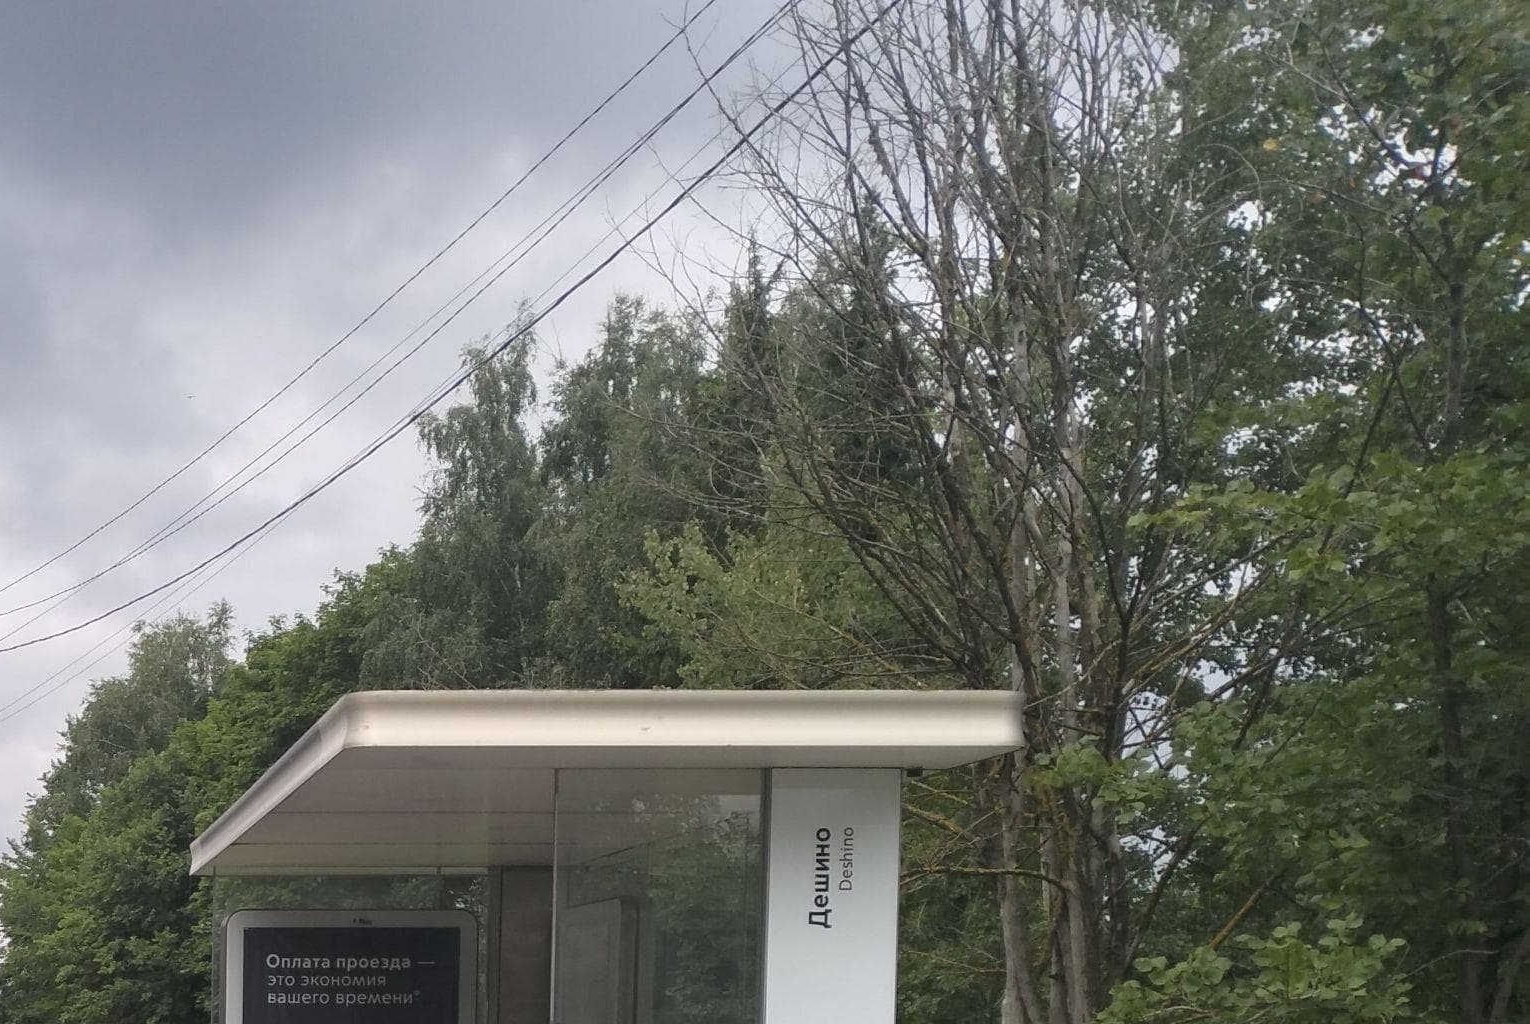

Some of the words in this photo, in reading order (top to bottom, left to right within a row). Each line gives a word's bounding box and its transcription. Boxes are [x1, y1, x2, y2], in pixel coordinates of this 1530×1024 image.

[838, 827, 854, 891] Deshino
[808, 827, 832, 929] Дешино
[266, 953, 331, 969] Оплата
[336, 955, 411, 972] проезда
[267, 974, 295, 987] это
[300, 974, 387, 987] экономия
[267, 991, 330, 1005] вашего
